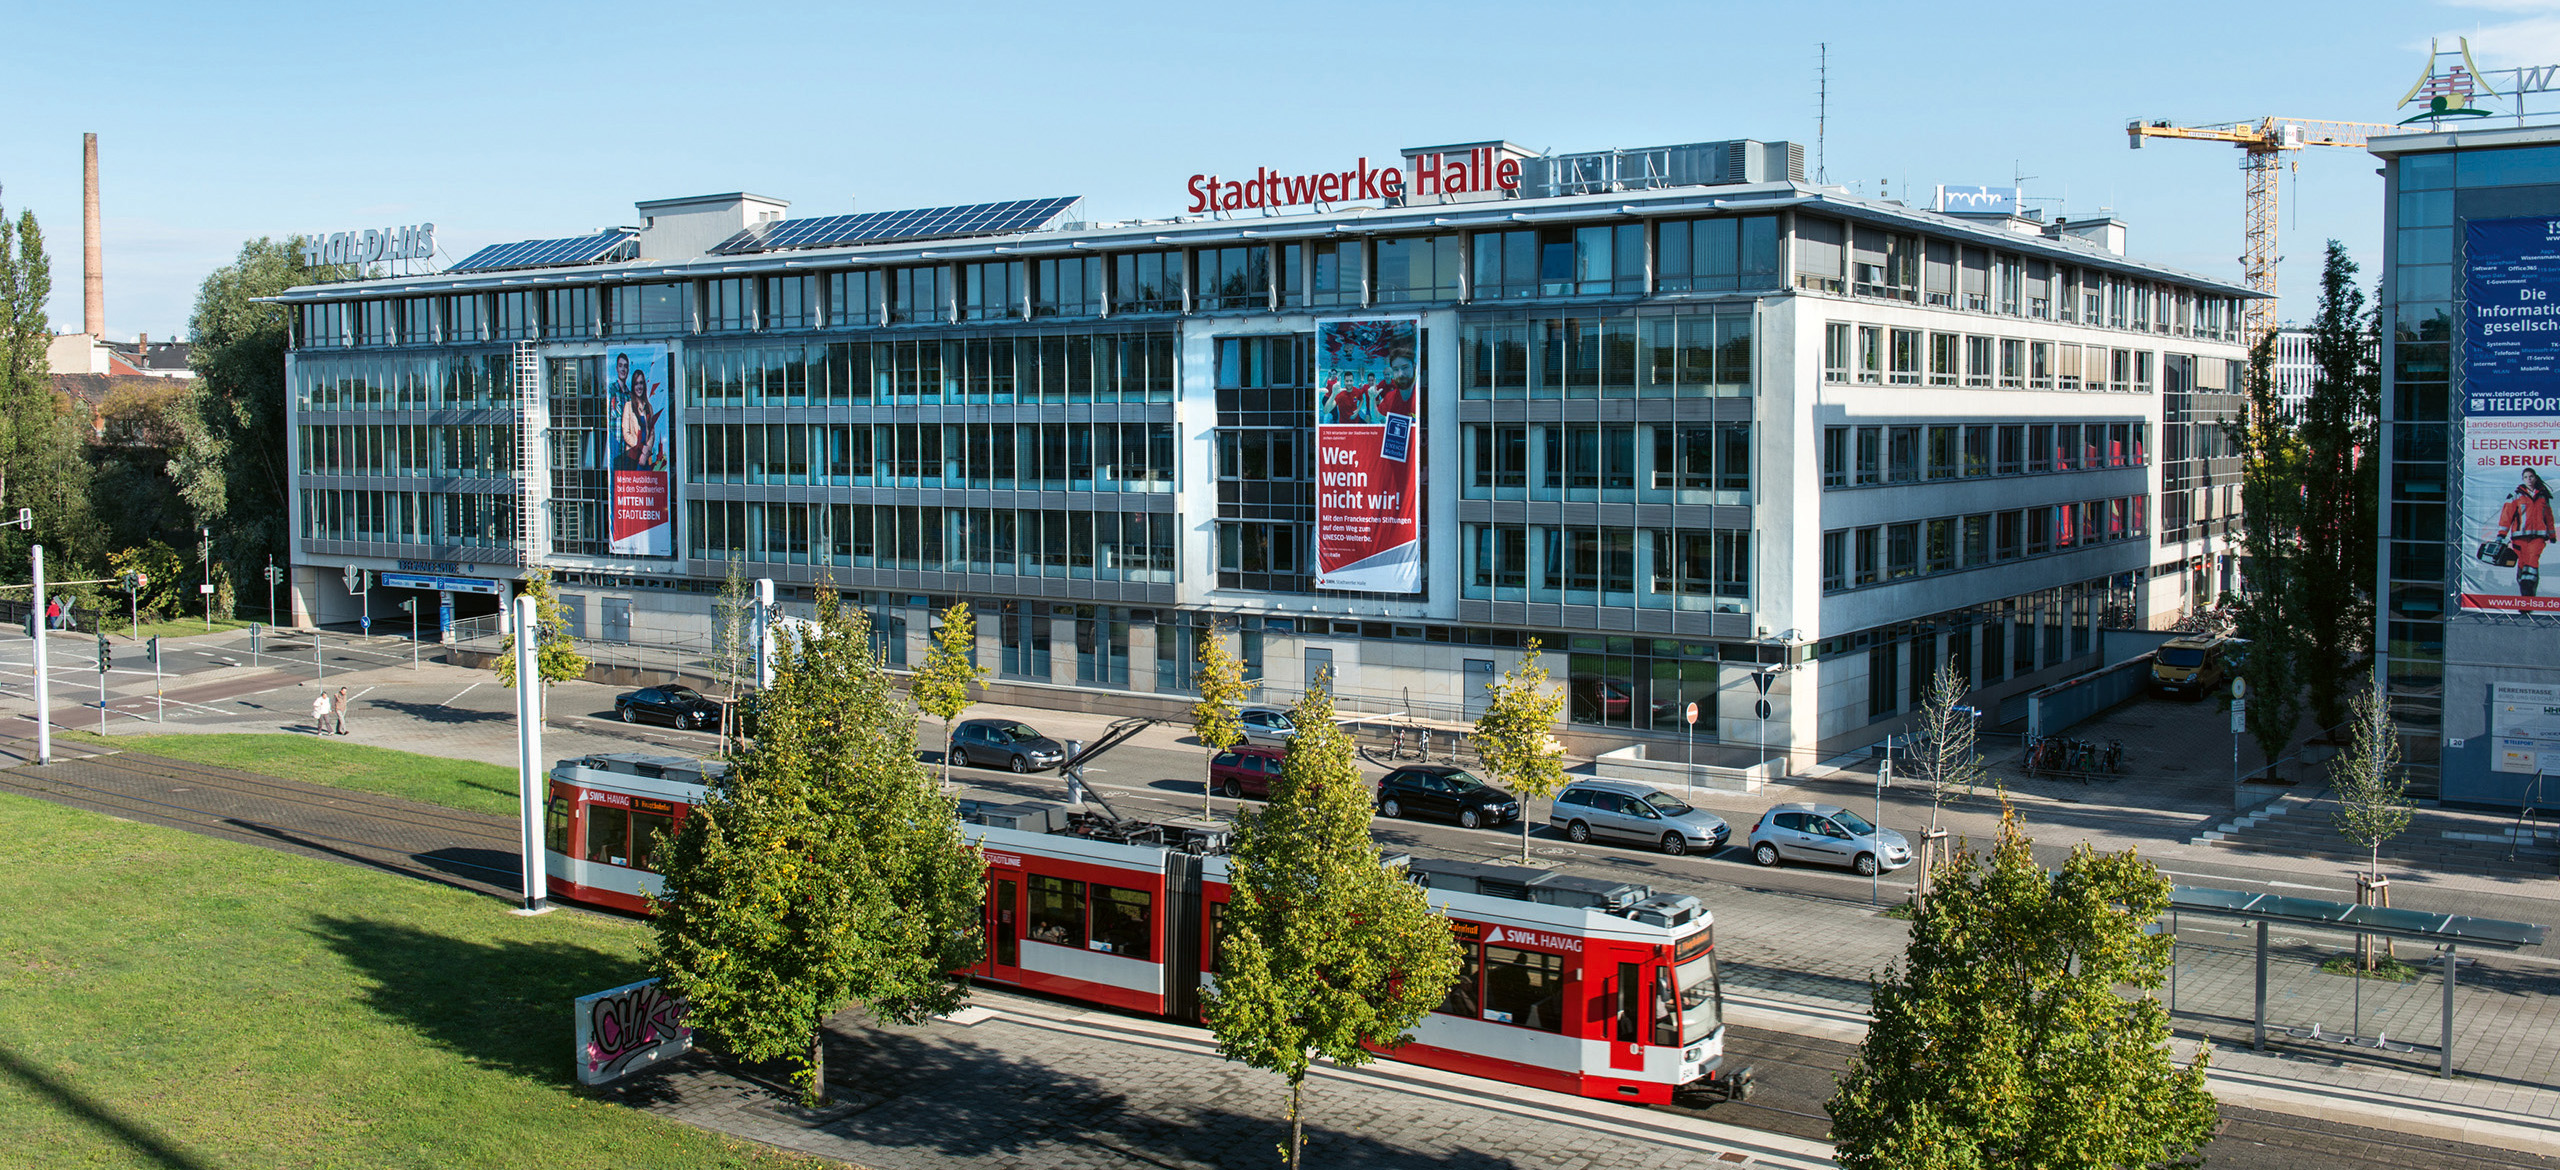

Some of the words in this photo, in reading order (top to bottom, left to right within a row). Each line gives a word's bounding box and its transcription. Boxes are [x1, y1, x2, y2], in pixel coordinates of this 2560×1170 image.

[1187, 157, 1403, 213] Stadtwerke
[1416, 147, 1522, 195] Halle
[1946, 186, 2002, 206] mdr
[2520, 288, 2547, 301] Die
[2483, 319, 2560, 336] gesellsch
[2471, 390, 2540, 398] www.teleport.de
[1322, 446, 1359, 468] Wer,
[2477, 455, 2496, 467] als
[617, 476, 632, 484] Meine
[633, 476, 658, 485] Ausbildung
[1322, 471, 1368, 488] wenn
[617, 485, 625, 493] bei
[636, 485, 665, 494] Stadtwerken
[617, 496, 644, 507] MITTEN
[645, 497, 655, 507] IM
[1322, 489, 1363, 510] nicht
[1367, 490, 1400, 511] wir!
[617, 509, 661, 520] STADTLEBEN
[1322, 514, 1332, 522] Mit
[1333, 515, 1344, 523] den
[1344, 515, 1381, 524] Franckeschen
[1382, 516, 1412, 526] Stiftungen
[1322, 524, 1332, 532] auf
[1345, 525, 1358, 533] Weg
[1322, 534, 1372, 543] UNESCO-Welterbe.
[2498, 687, 2552, 695] HERRENSTRASSE
[607, 793, 630, 806] HAVAG
[986, 854, 1022, 867] STADTLINIE
[1507, 929, 1538, 946] SWH.
[1540, 935, 1583, 952] HAVAG
